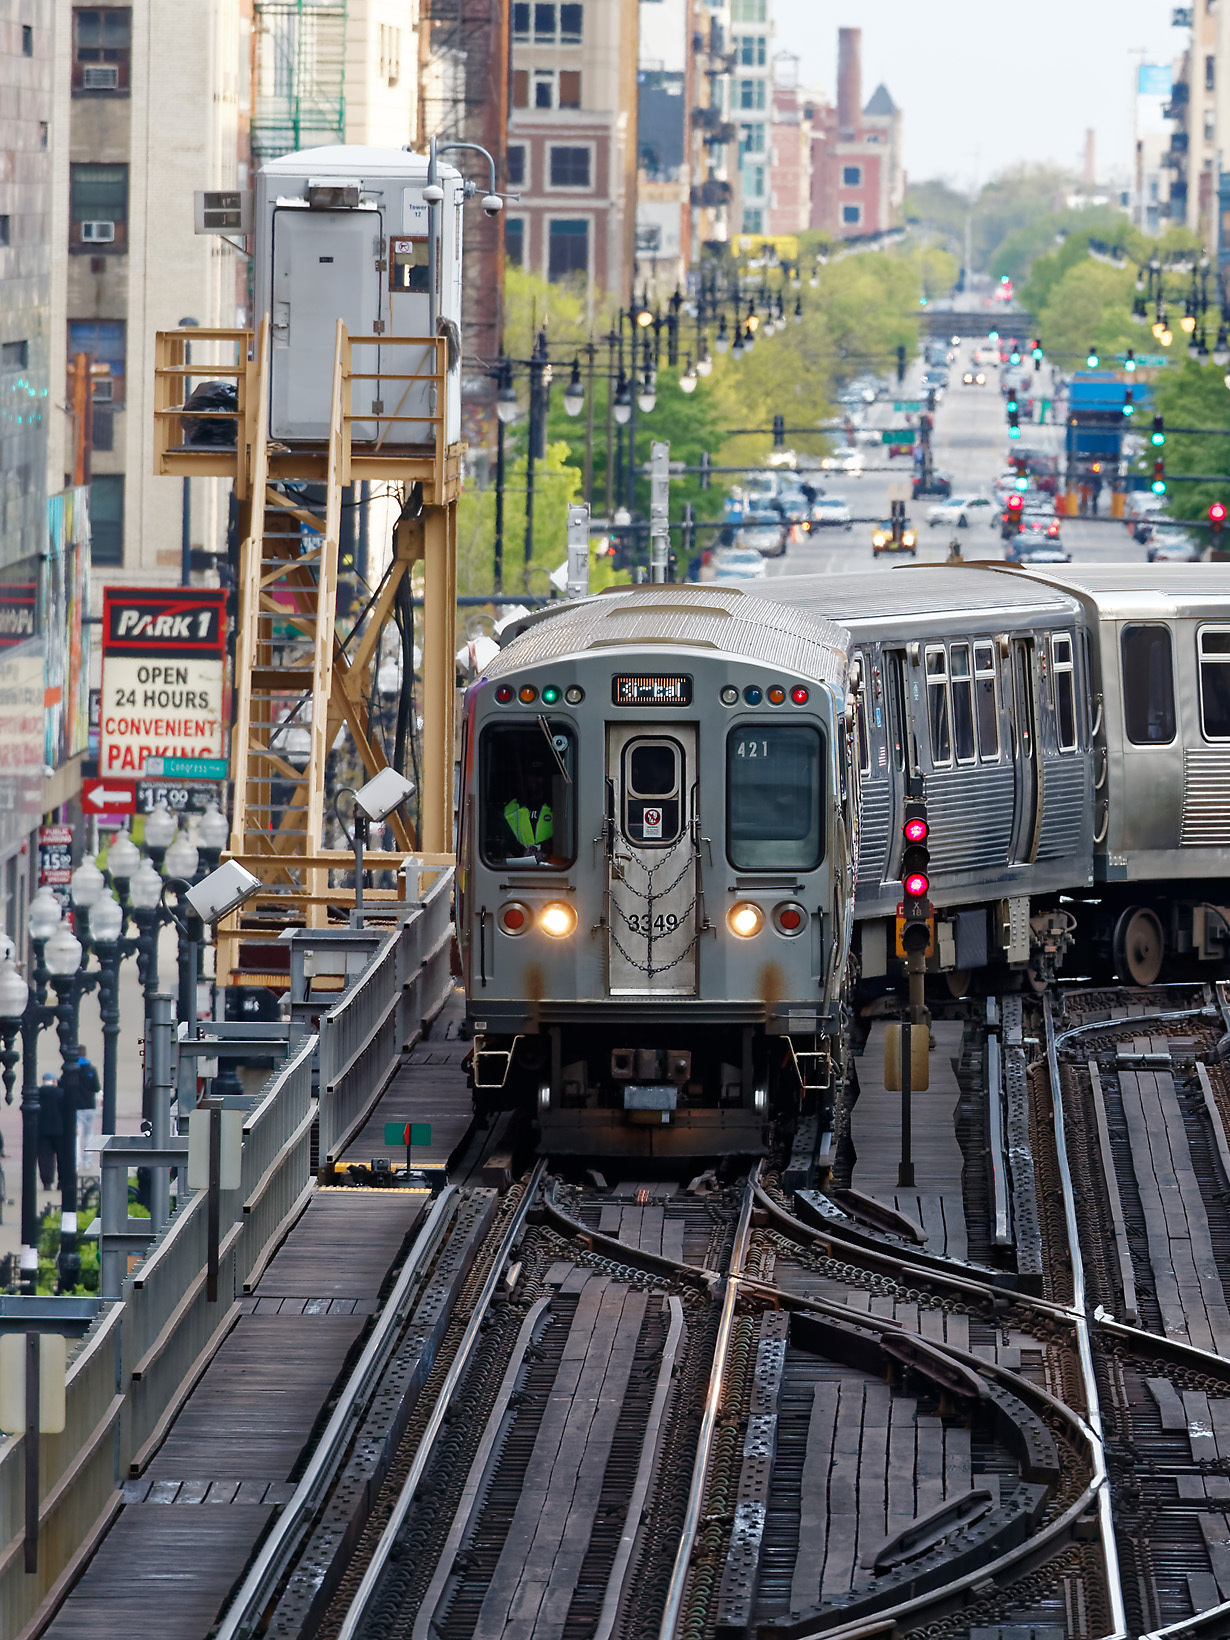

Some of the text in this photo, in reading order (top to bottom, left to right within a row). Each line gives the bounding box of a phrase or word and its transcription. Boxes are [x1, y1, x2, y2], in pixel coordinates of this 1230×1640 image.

[118, 609, 212, 638] PARK 1
[137, 667, 188, 684] OPEN
[116, 690, 208, 708] 24 HOURS
[105, 718, 216, 737] CONVENIENT
[737, 741, 768, 757] 421
[170, 761, 208, 773] Congress
[628, 914, 678, 932] 3349
